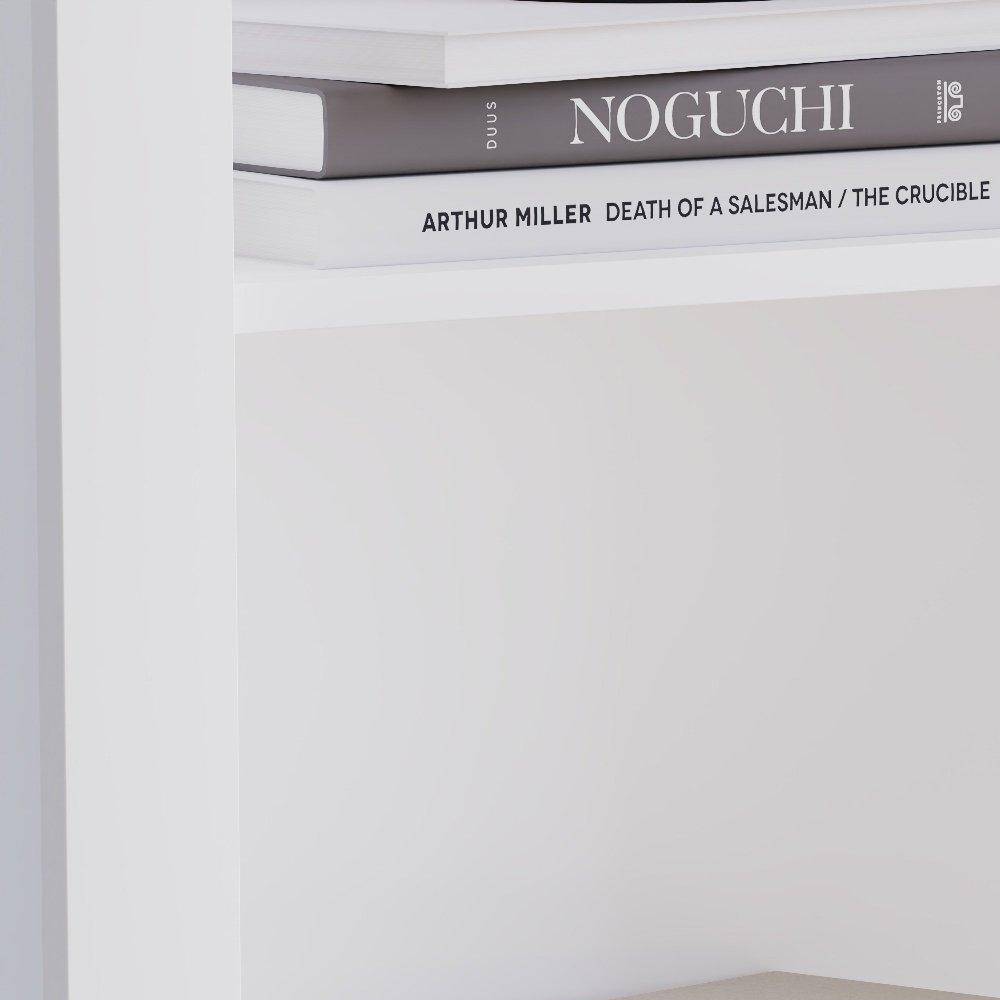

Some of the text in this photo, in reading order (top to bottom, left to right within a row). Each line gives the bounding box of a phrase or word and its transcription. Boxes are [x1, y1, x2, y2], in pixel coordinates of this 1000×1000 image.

[486, 101, 498, 150] DUUS
[569, 83, 854, 145] NOGUCHI
[422, 180, 990, 233] ARTHUR MILLER DEATH OF A SALESMAN / THE CRUCIBLE
